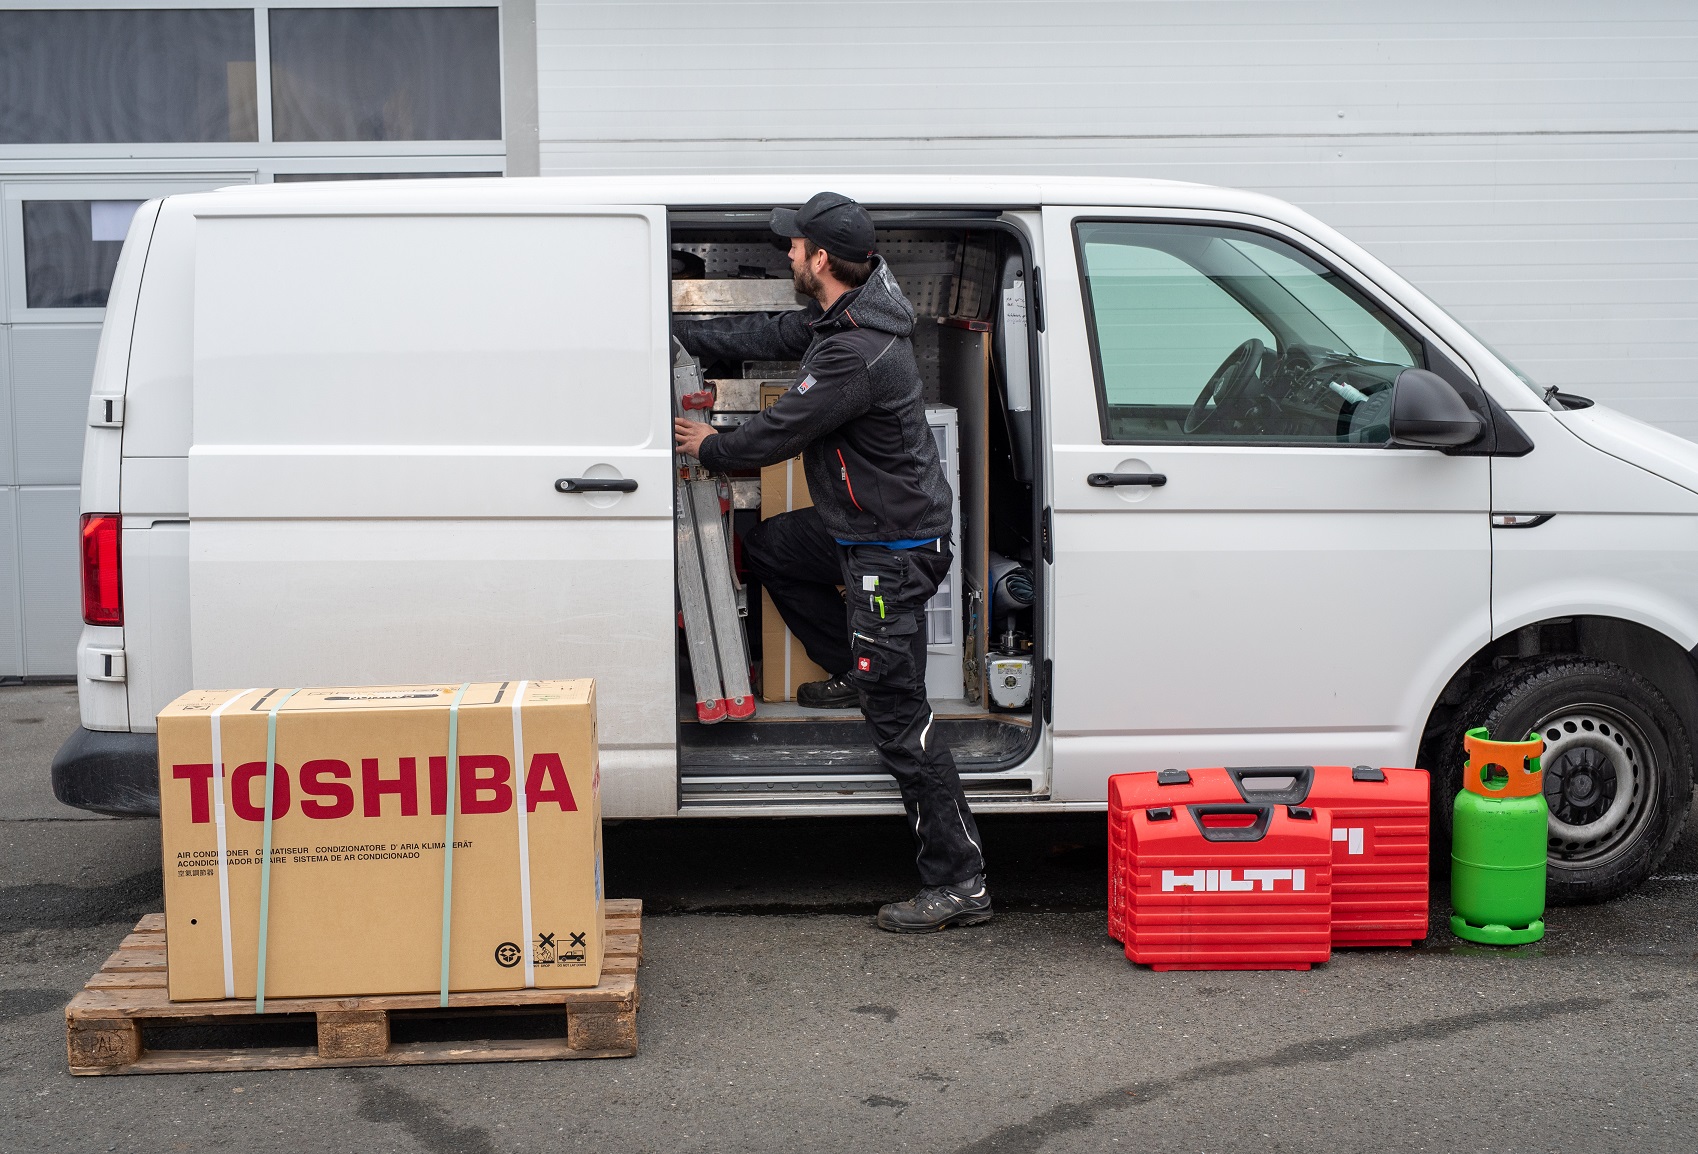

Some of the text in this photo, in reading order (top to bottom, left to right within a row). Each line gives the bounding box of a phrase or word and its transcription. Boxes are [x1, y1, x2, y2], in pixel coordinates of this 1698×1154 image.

[172, 752, 579, 824] TOSHIBA
[177, 858, 253, 868] ACONDICIADOR
[293, 855, 329, 863] SISTEMA
[357, 852, 420, 861] CONDICIONADO
[193, 849, 249, 859] CONDIONER
[255, 847, 309, 856] CMATISEUR
[315, 844, 386, 854] CONDIZIONATORE
[421, 840, 473, 850] KLIMAERÄT
[1161, 869, 1306, 892] HILTI
